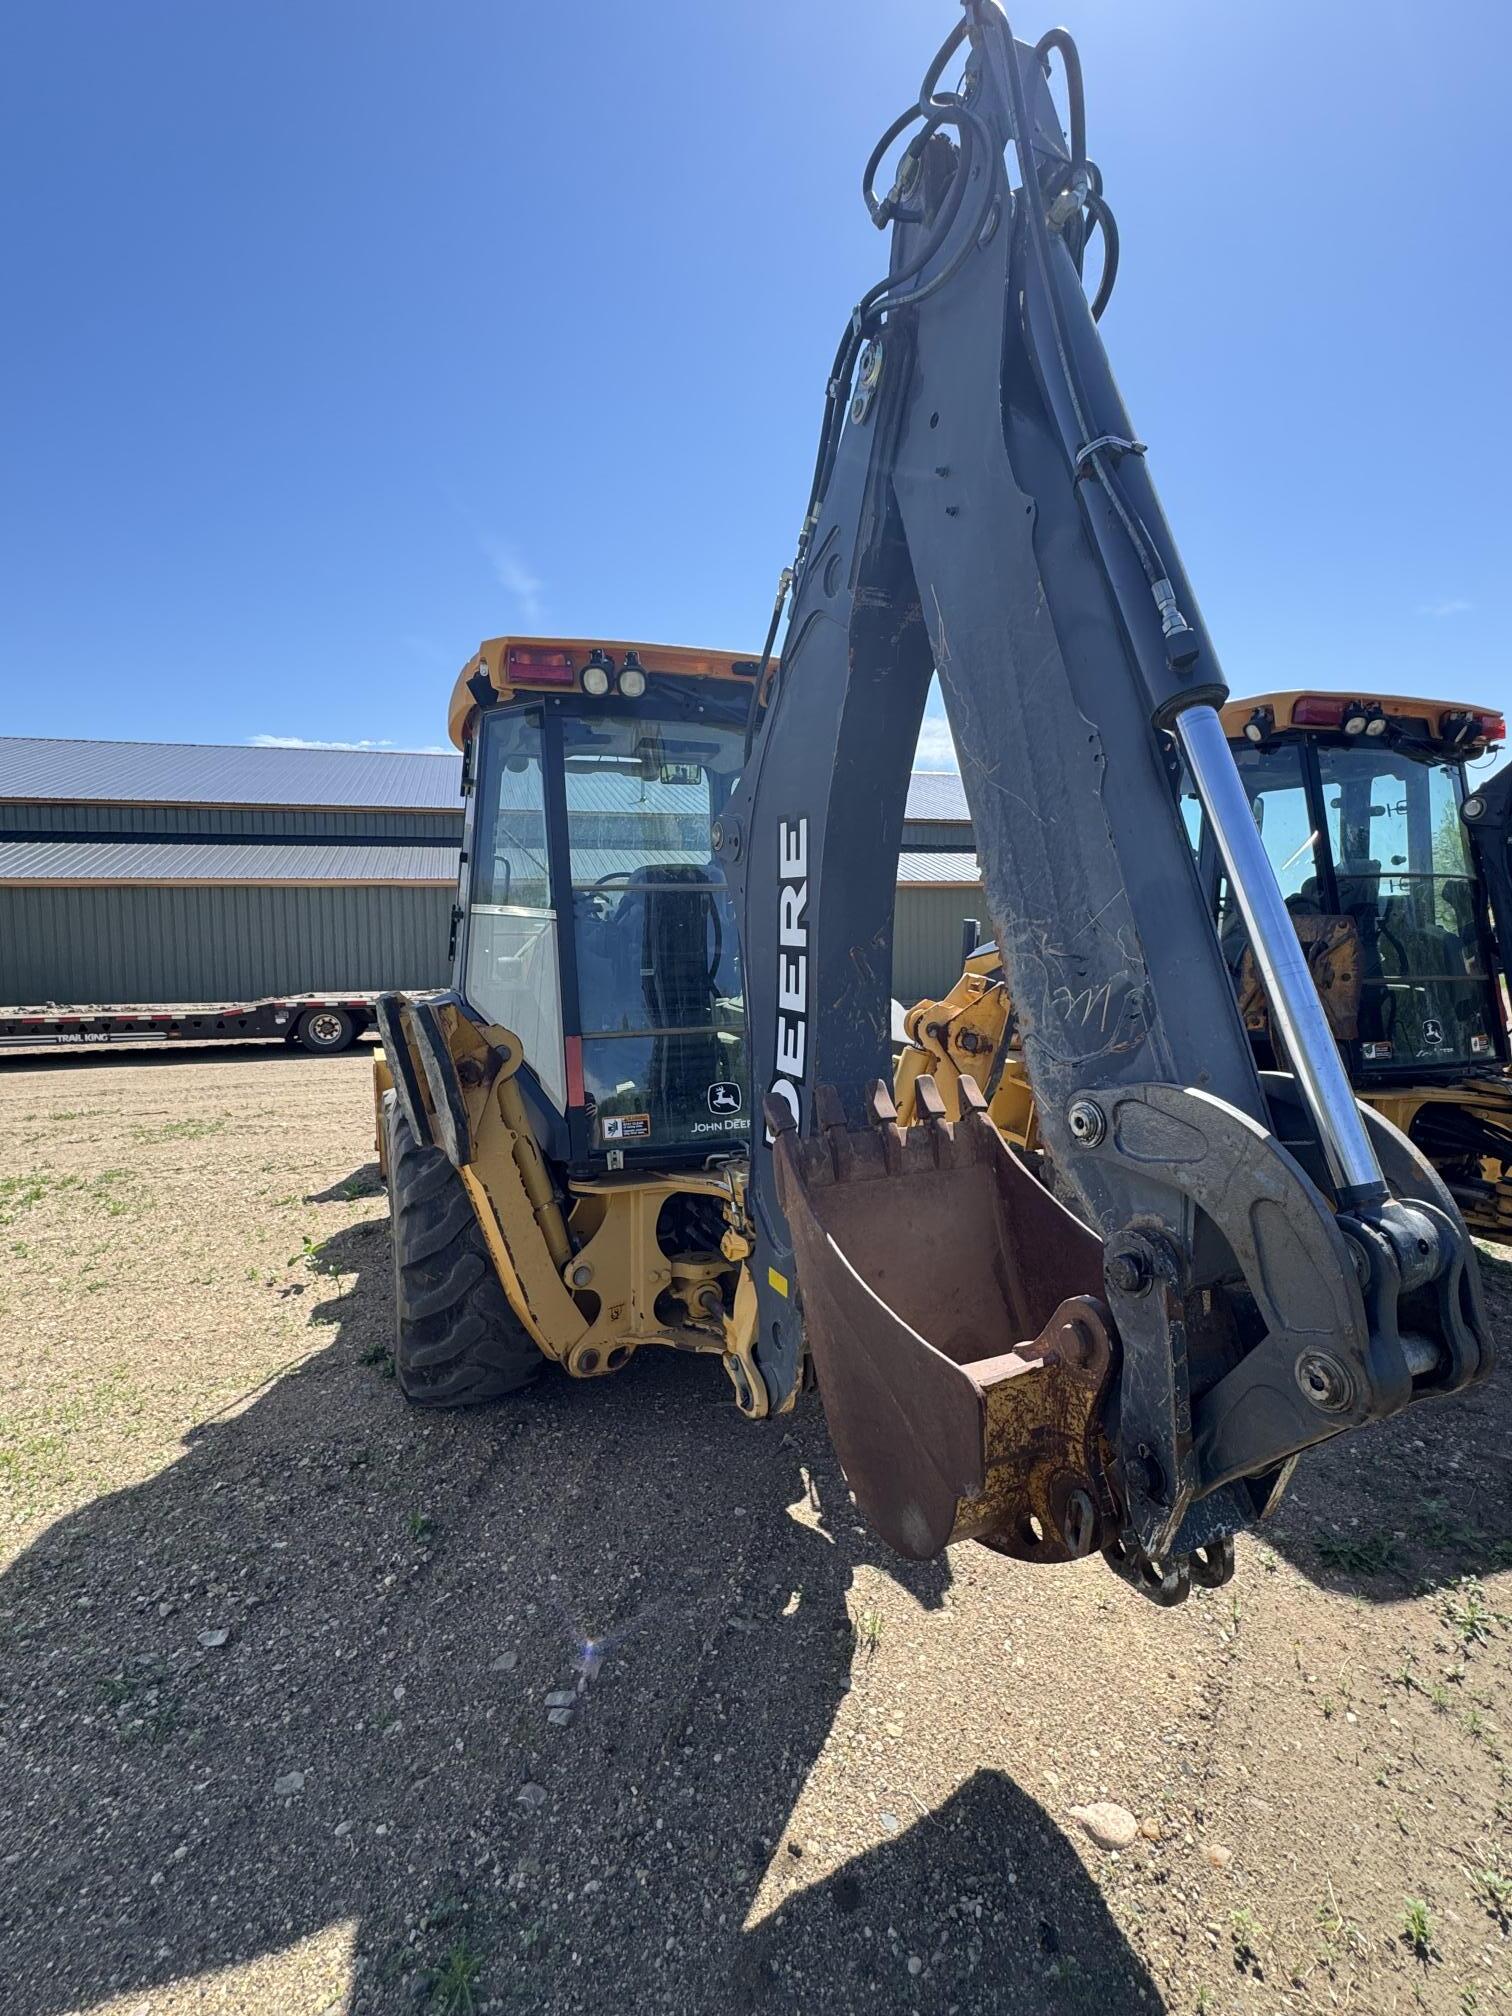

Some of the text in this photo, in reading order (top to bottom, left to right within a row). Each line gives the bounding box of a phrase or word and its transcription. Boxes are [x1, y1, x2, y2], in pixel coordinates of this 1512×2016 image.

[56, 1033, 108, 1043] TRAIL KING
[690, 1119, 751, 1133] JOHN DEE
